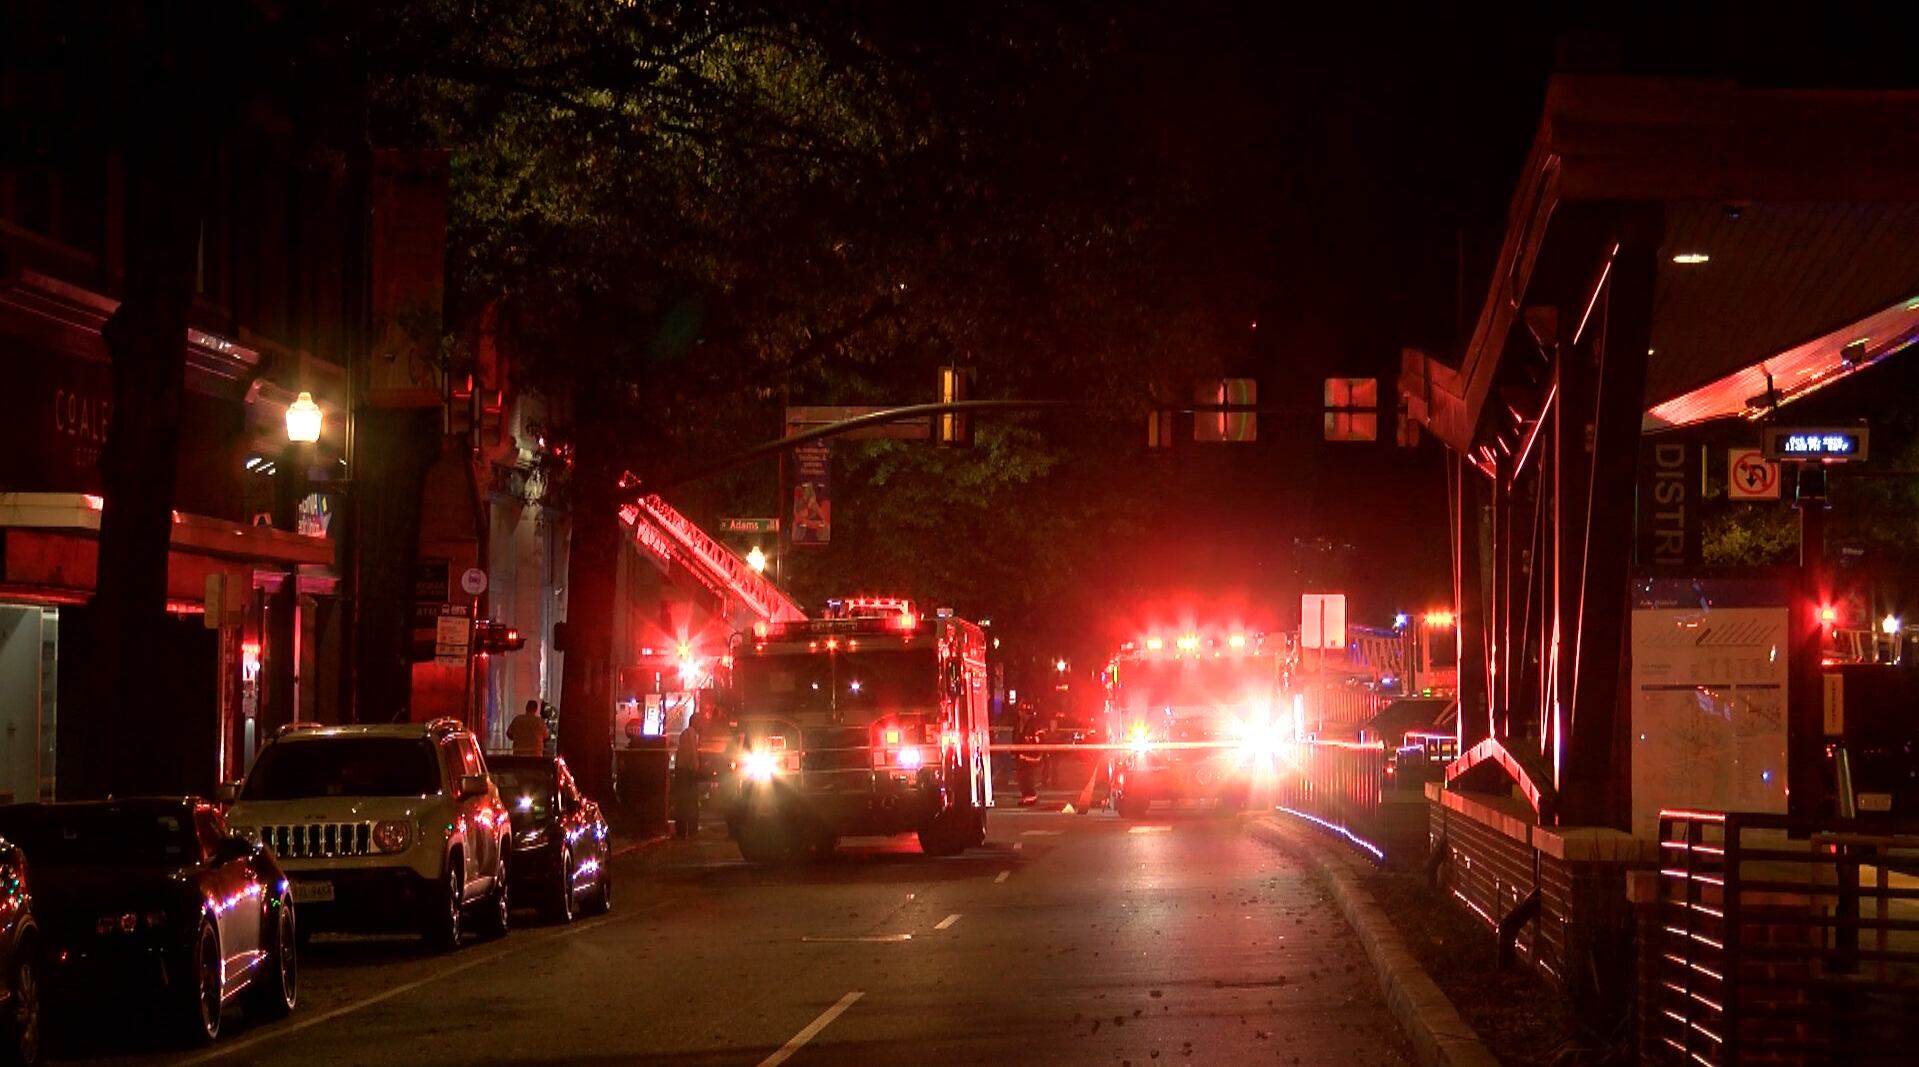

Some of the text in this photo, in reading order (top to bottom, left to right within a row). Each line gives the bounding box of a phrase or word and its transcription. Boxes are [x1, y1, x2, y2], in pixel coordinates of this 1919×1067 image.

[56, 389, 113, 444] COALE
[1655, 443, 1685, 565] DISTRI
[730, 519, 759, 529] Adams
[415, 607, 438, 617] ATM
